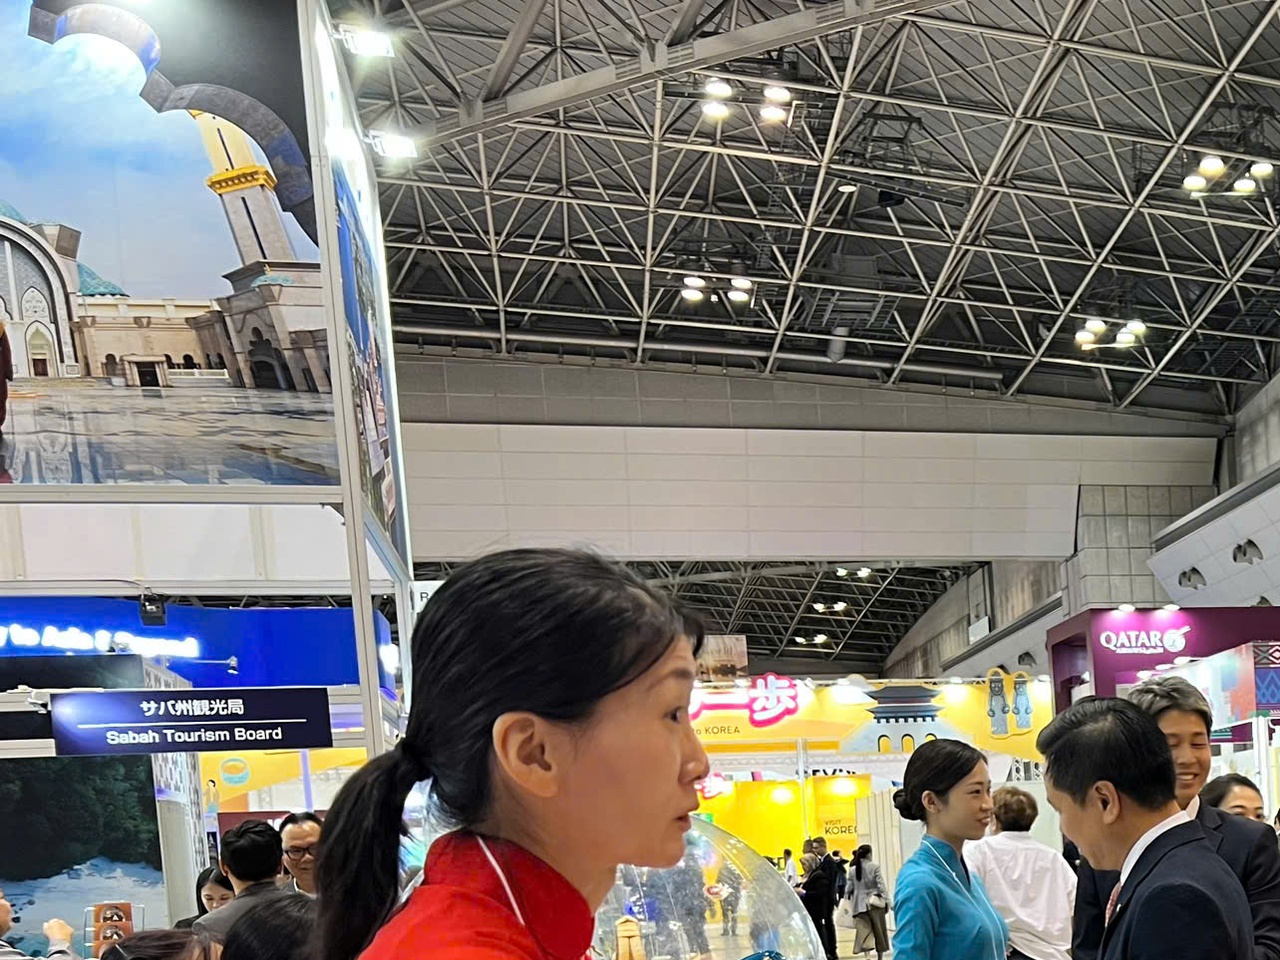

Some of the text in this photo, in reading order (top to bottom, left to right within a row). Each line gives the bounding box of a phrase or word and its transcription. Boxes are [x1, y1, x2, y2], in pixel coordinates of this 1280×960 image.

[1100, 630, 1164, 650] QATAR
[139, 699, 244, 717] サバ州観光局
[106, 726, 282, 745] Sabah Tourism Board
[704, 726, 740, 735] KOREA
